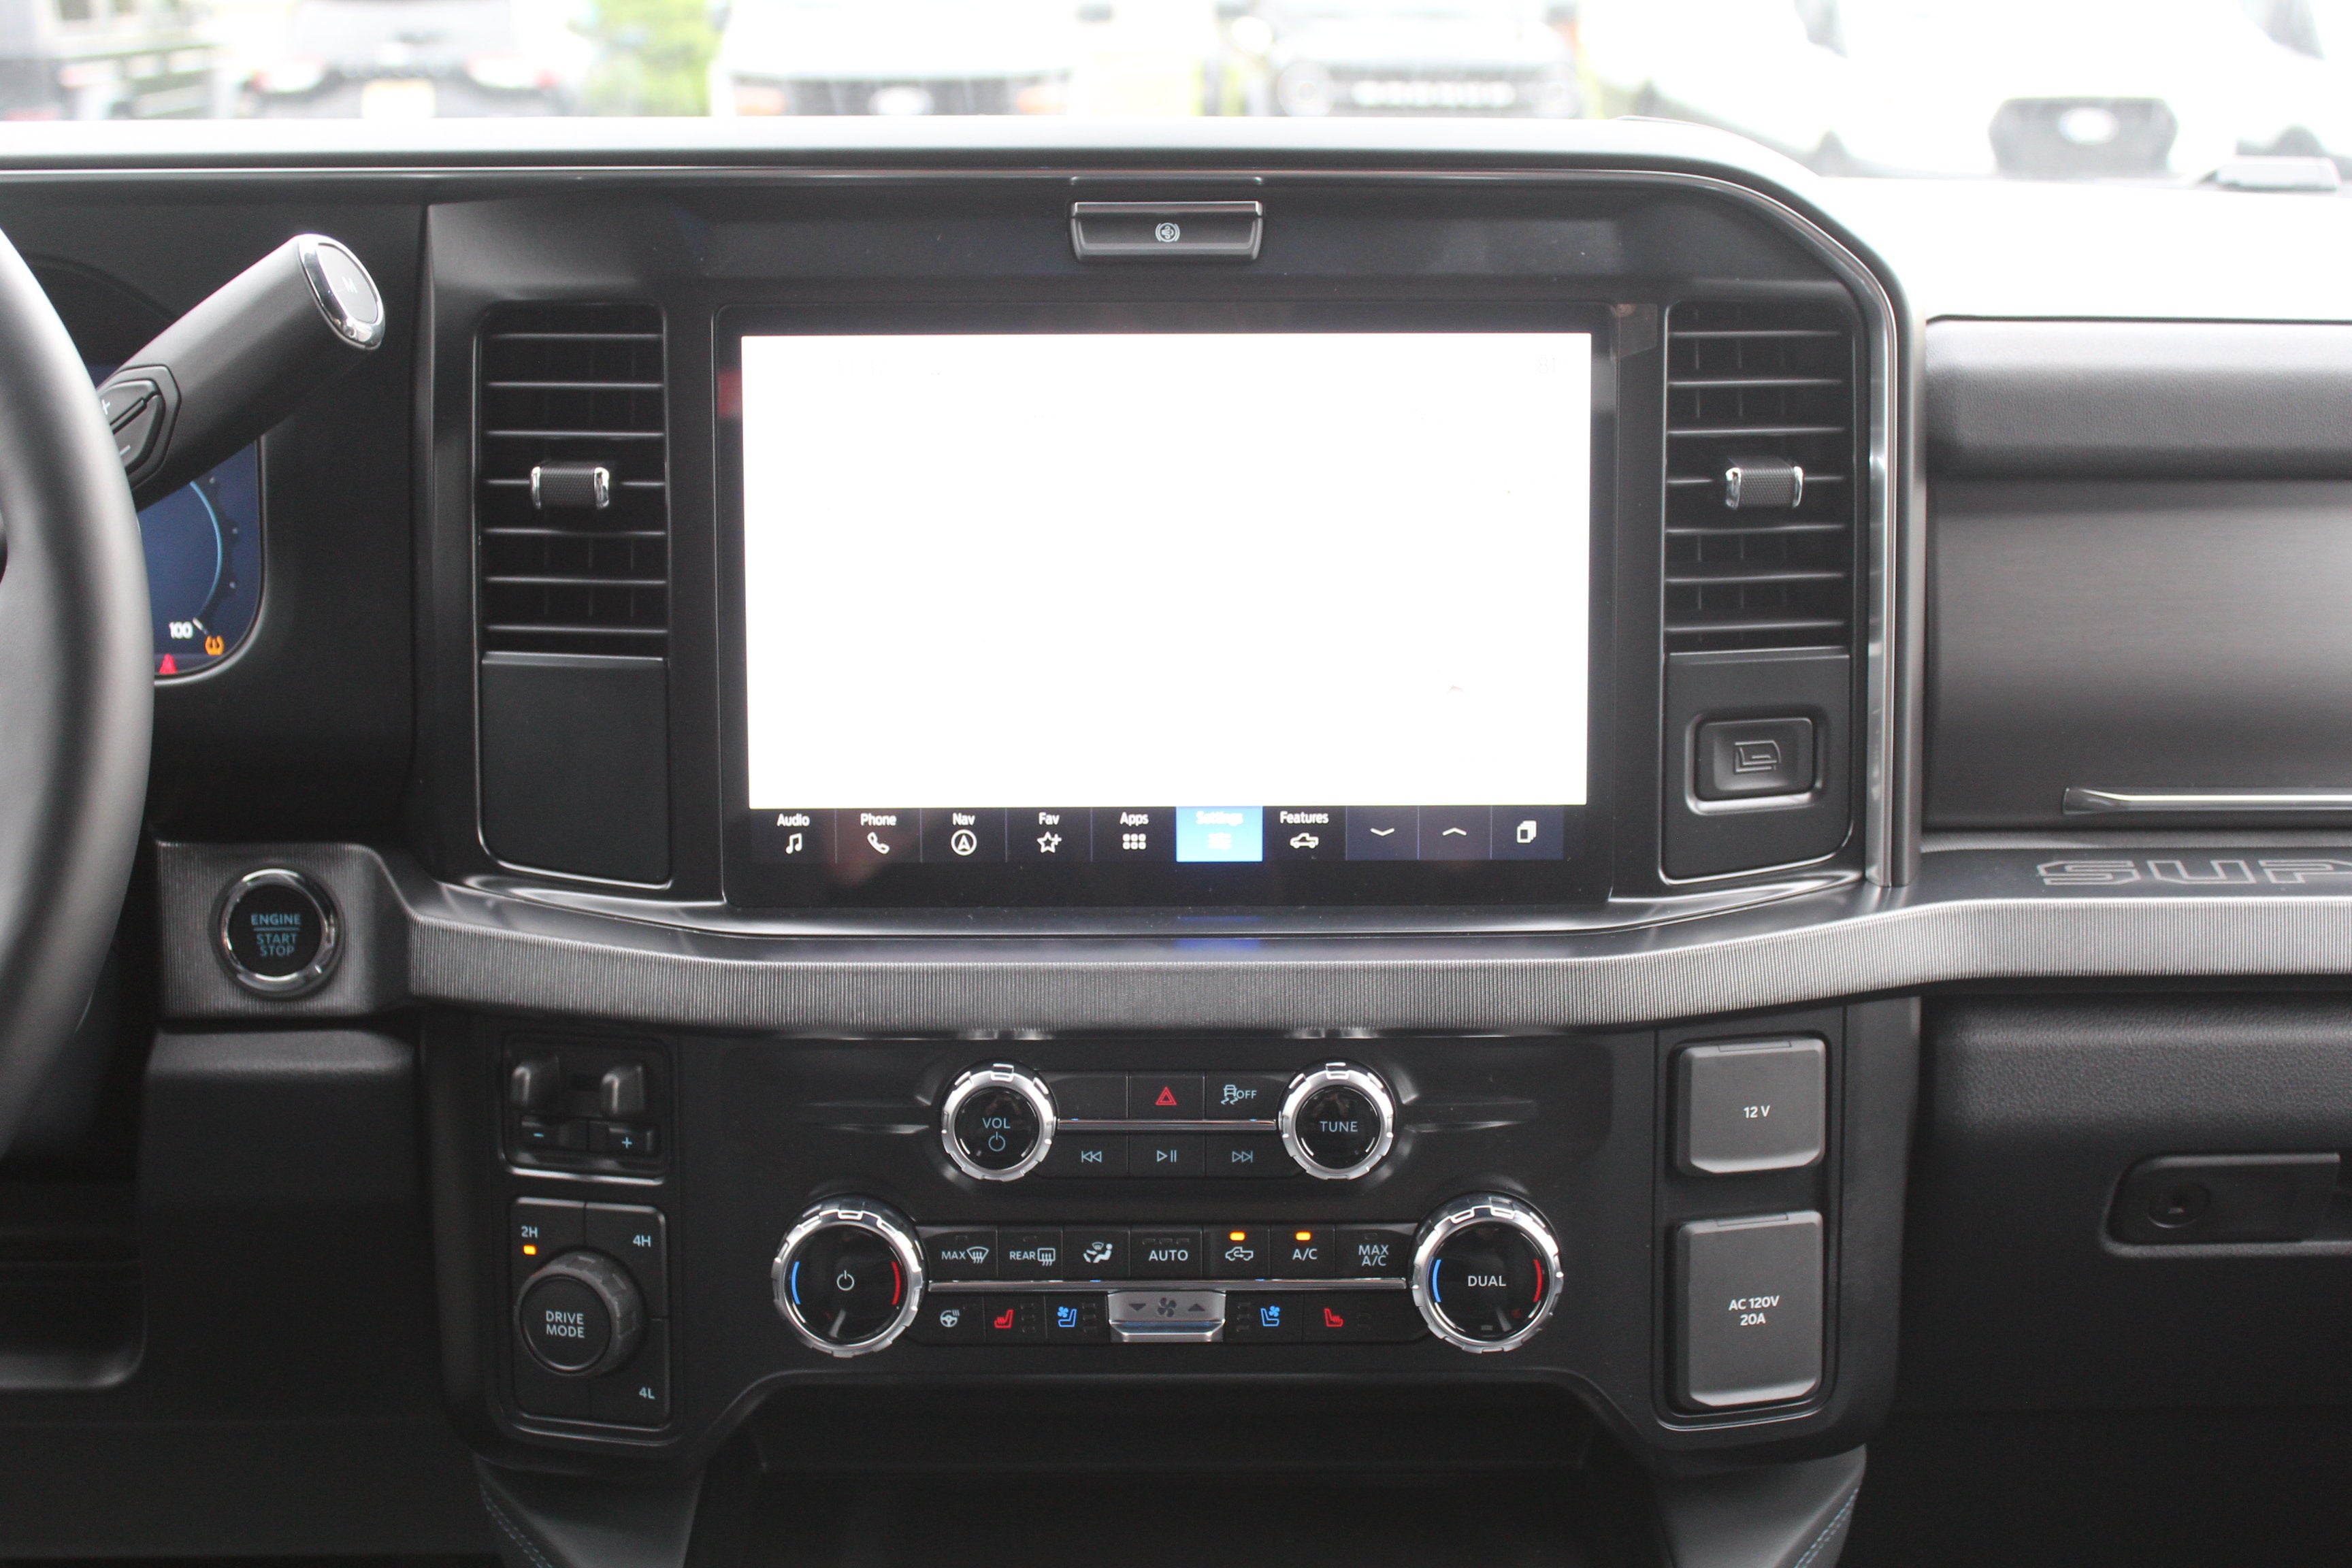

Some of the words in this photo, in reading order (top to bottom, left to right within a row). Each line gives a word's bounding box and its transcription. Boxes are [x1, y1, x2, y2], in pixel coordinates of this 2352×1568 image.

[169, 621, 193, 639] 100
[777, 813, 811, 827] Audio
[860, 813, 897, 826] Phone
[952, 812, 976, 826] Nav
[1039, 811, 1060, 826] Fav
[1120, 811, 1149, 827] Apps
[1196, 811, 1244, 827] Settings
[1279, 810, 1329, 824] Features
[250, 913, 301, 926] ENGINE
[256, 933, 297, 945] START
[260, 945, 295, 957] STOP
[1236, 1090, 1258, 1101] OFF
[1744, 1106, 1758, 1119] 12
[1760, 1105, 1770, 1117] V
[982, 1117, 1011, 1129] VOL
[1320, 1121, 1359, 1132] TUNE
[521, 1226, 539, 1239] 2H
[632, 1235, 652, 1248] 4H
[941, 1250, 966, 1261] MAX
[1009, 1250, 1036, 1261] REAR
[1148, 1249, 1189, 1262] AUTO
[1292, 1247, 1318, 1262] A/C
[1358, 1244, 1389, 1256] MAX
[1361, 1255, 1386, 1267] A/C
[1467, 1275, 1507, 1288] DUAL
[1728, 1298, 1746, 1311] AC
[1748, 1295, 1780, 1309] 120V
[546, 1310, 584, 1324] DRIVE
[1740, 1312, 1766, 1326] 20A
[546, 1323, 585, 1339] MODE
[638, 1387, 655, 1400] 4L
